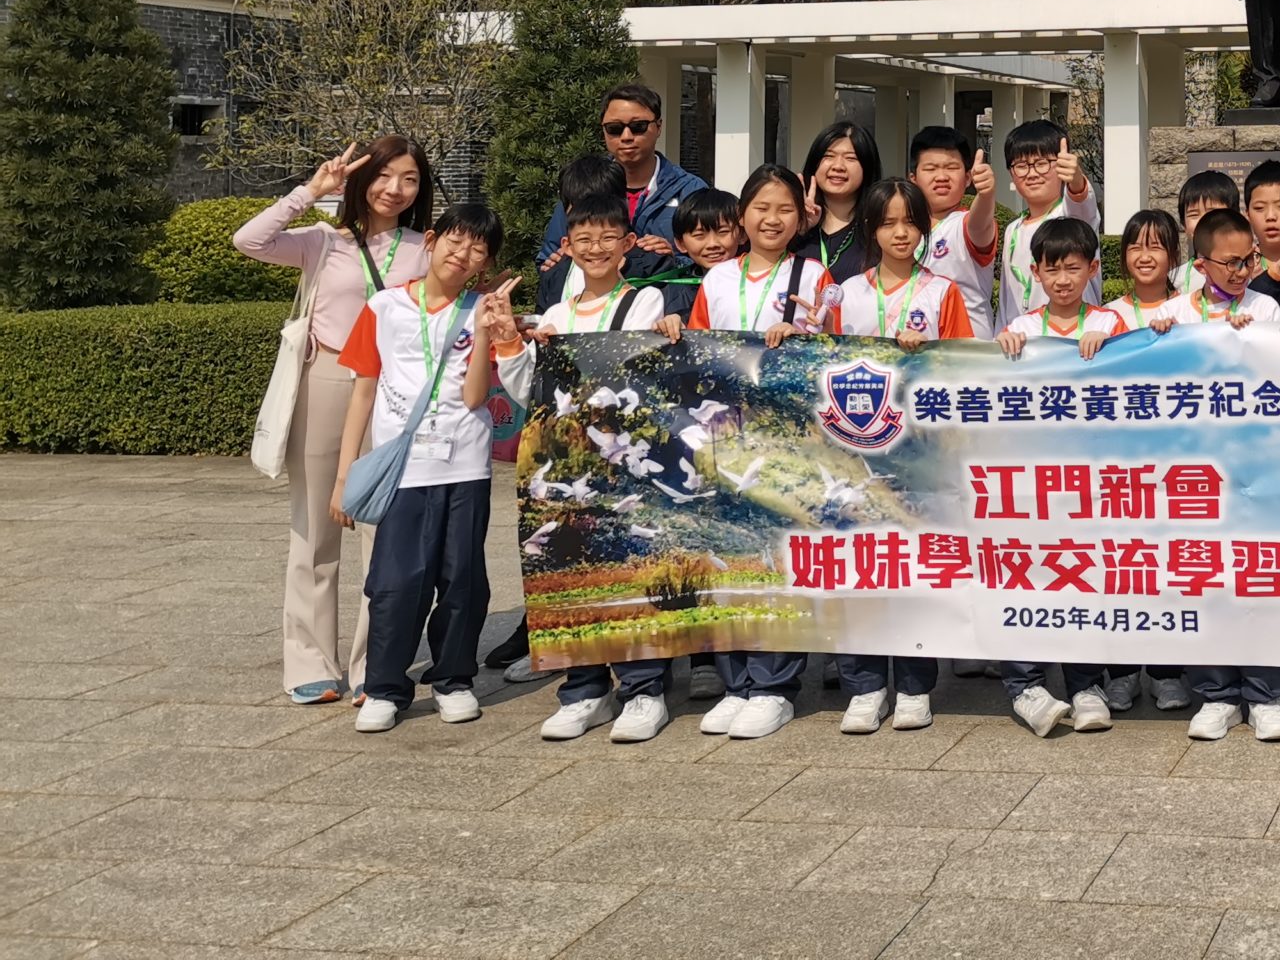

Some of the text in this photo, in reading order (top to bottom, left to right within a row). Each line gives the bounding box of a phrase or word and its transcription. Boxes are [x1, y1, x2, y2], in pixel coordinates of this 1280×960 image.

[969, 464, 1223, 520] 江門新會
[1002, 606, 1199, 633] 2025年4月2-3日
